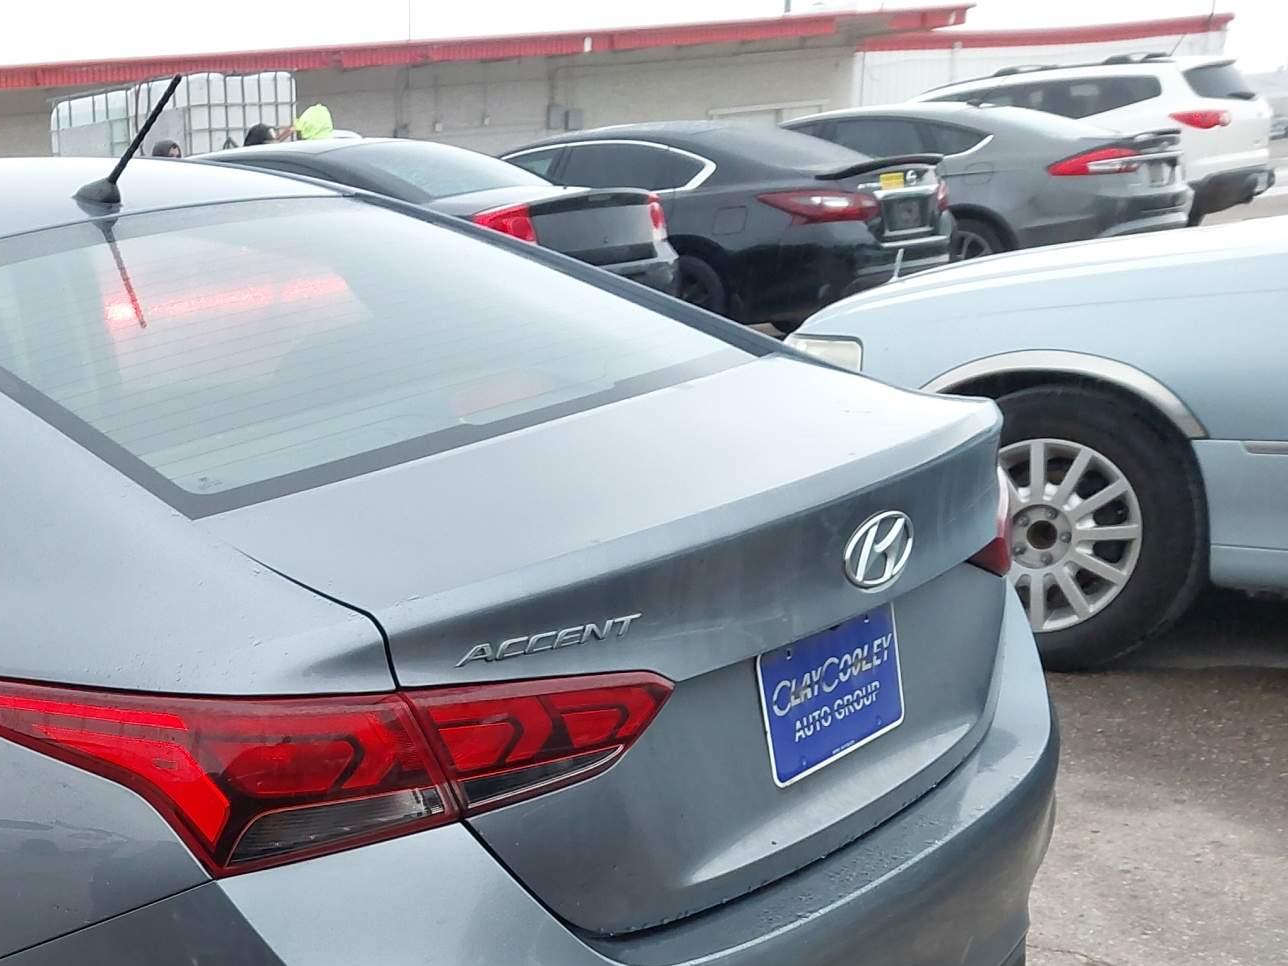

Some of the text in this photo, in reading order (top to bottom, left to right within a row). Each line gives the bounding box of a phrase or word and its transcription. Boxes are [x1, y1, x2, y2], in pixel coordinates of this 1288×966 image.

[455, 612, 642, 668] ACCENT
[794, 680, 880, 743] AUTO GROUP
